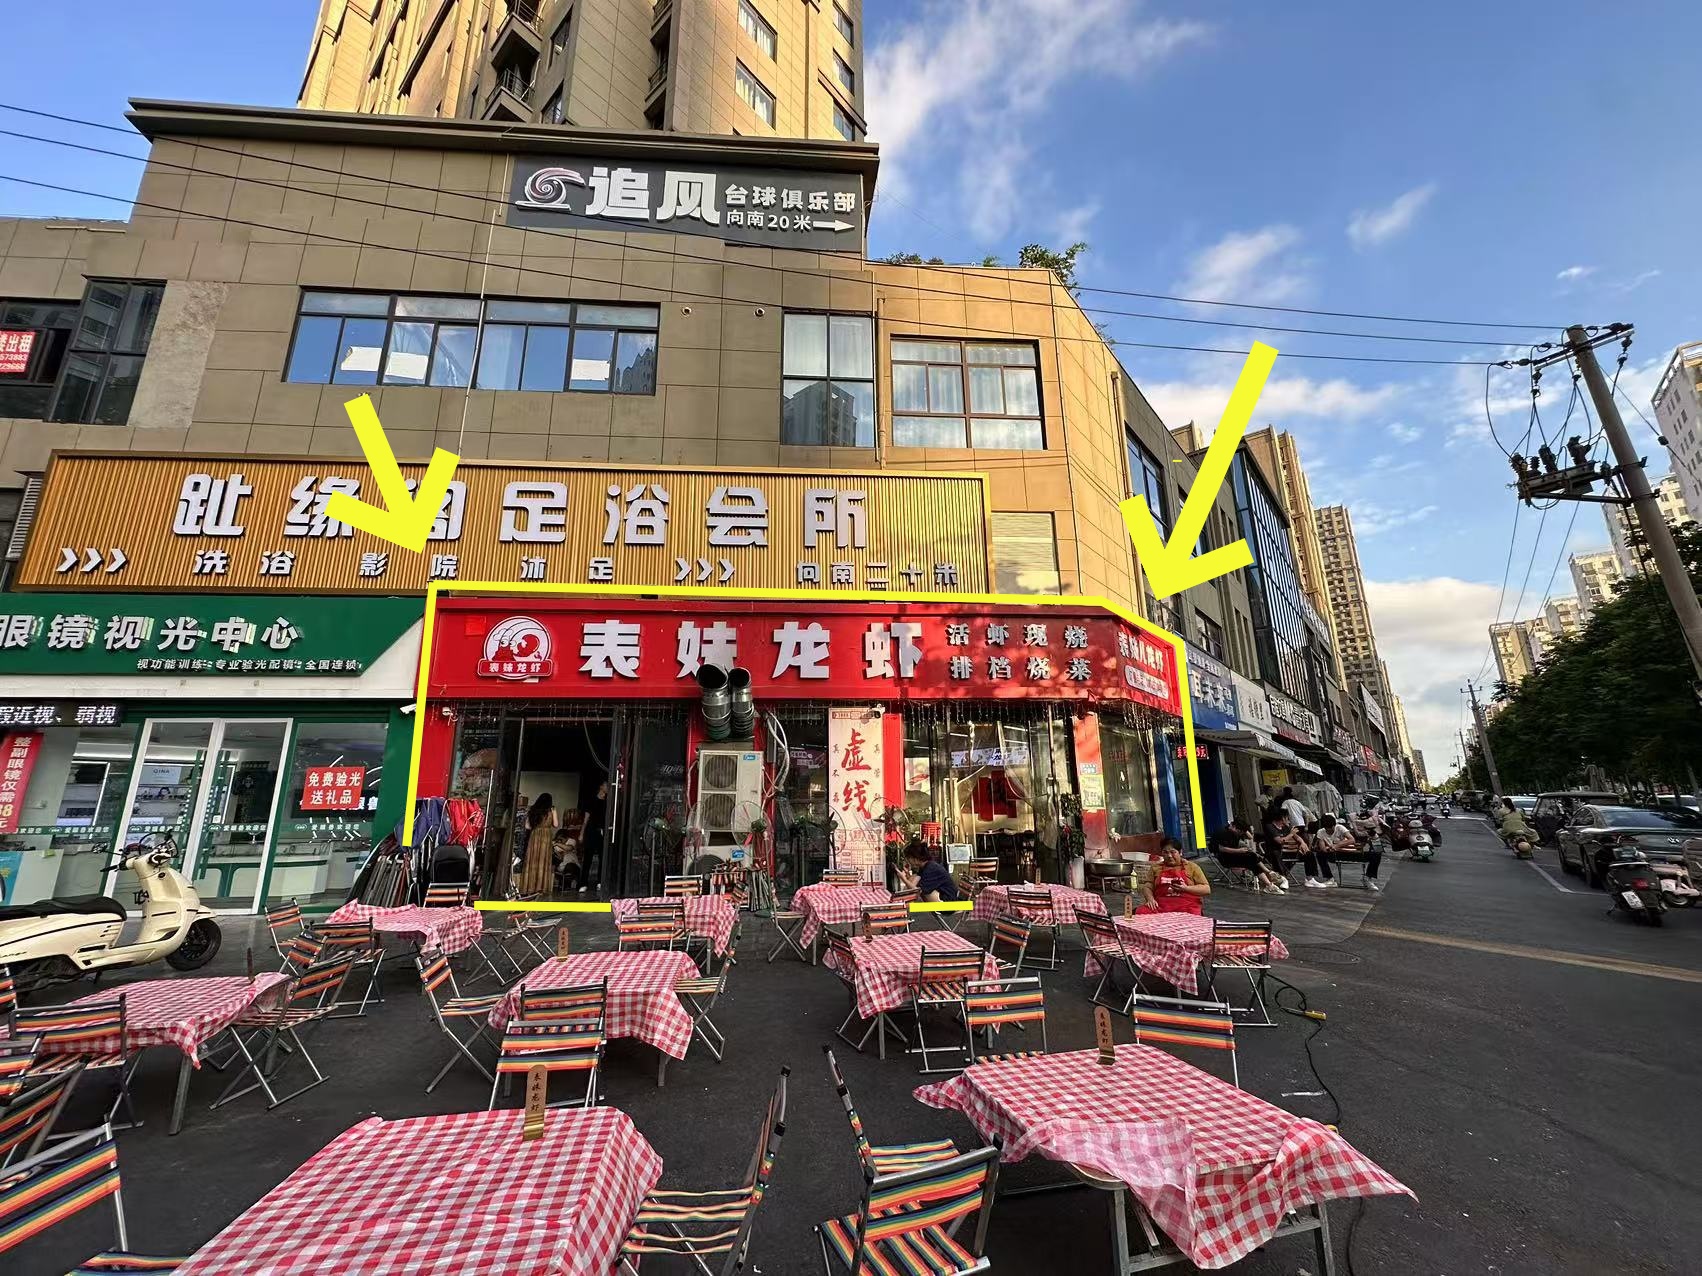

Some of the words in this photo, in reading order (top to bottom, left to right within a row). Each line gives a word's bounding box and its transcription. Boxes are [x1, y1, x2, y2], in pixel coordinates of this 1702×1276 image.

[585, 166, 720, 225] 追风
[725, 184, 857, 212] 台球俱乐部
[726, 211, 812, 231] 向南20米
[193, 549, 296, 577] 洗浴
[358, 552, 459, 578] 影院
[519, 555, 615, 583] 沐足
[796, 560, 959, 586] 向南二十米
[0, 614, 300, 652] 眼镜视光中心
[946, 623, 1090, 649] 活虾现烧
[579, 619, 924, 681] 表妹龙虾
[136, 658, 206, 671] 视功能训练
[214, 659, 296, 671] 专业验光配镜
[304, 659, 360, 671] 全国连锁
[488, 662, 542, 673] 表妹龙虾
[950, 655, 1092, 681] 排档烧菜
[307, 772, 362, 788] 免费验光
[310, 789, 353, 805] 送礼品
